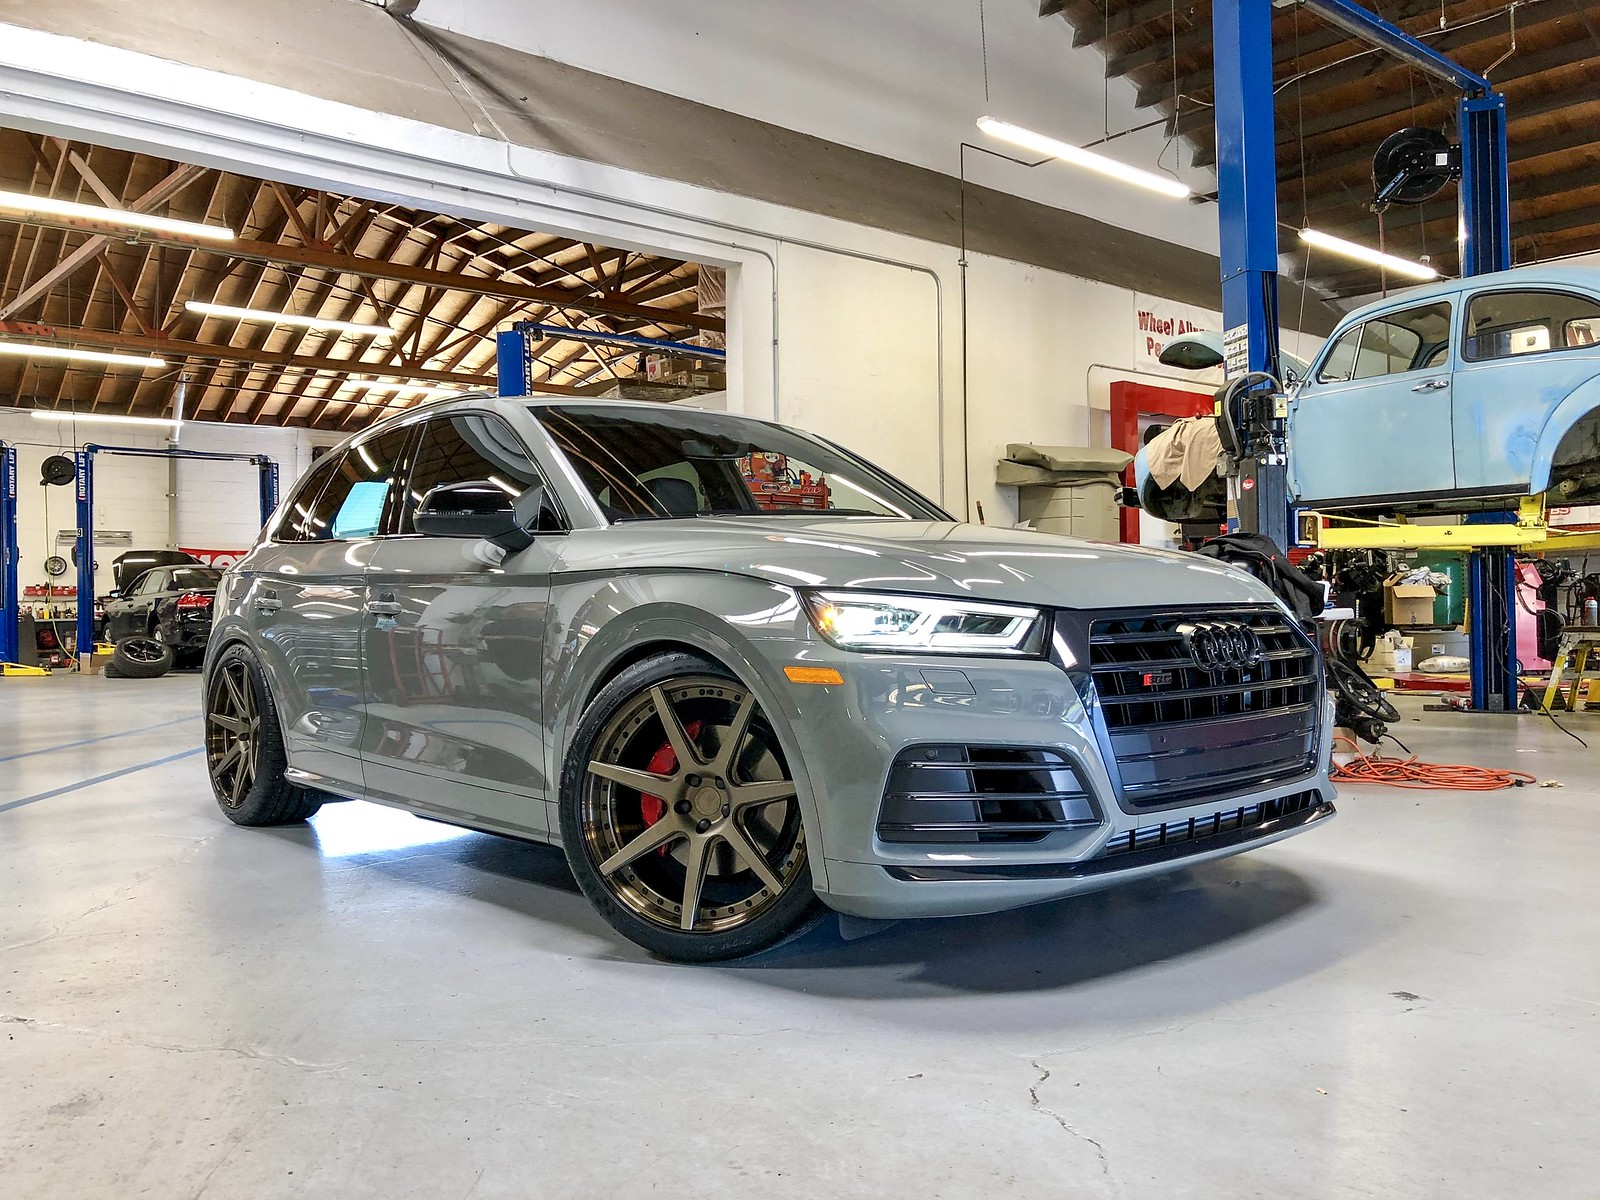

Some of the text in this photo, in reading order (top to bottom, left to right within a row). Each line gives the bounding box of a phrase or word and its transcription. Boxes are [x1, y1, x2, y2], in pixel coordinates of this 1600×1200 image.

[1138, 310, 1174, 336] Wheel
[78, 453, 86, 497] ROTARY LIFT
